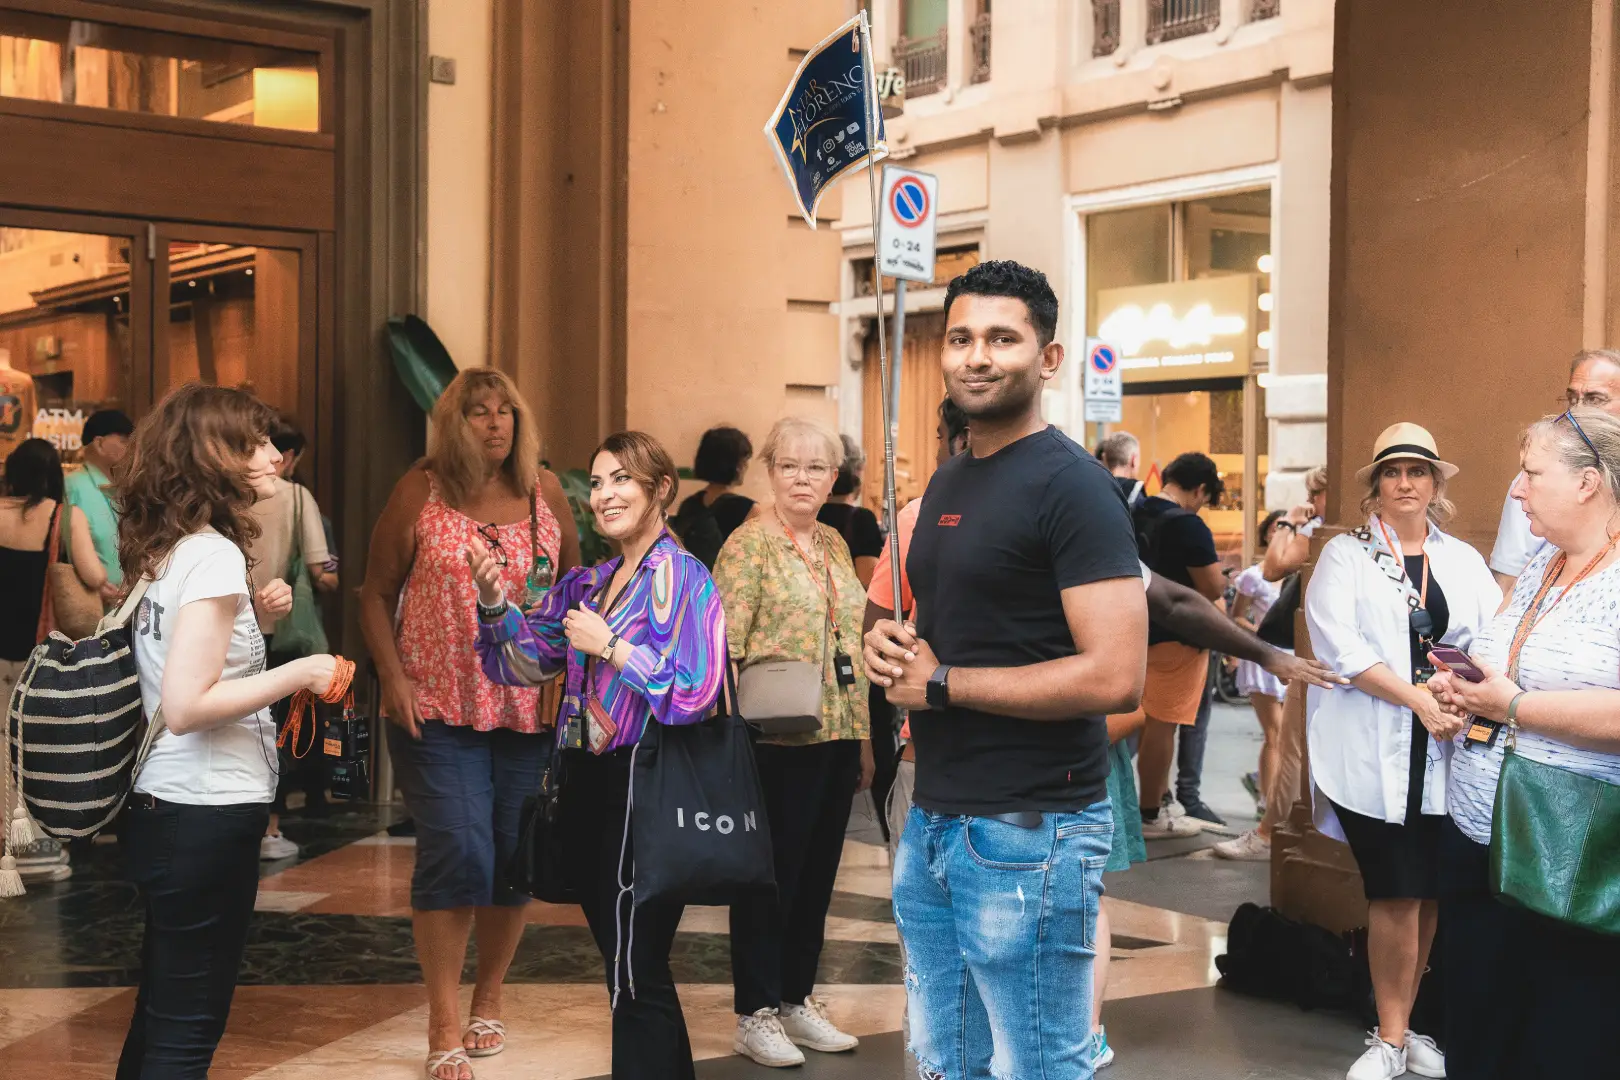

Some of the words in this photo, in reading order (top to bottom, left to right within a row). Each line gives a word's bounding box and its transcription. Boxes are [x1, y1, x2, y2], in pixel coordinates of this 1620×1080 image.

[796, 78, 818, 118] STAR
[34, 407, 83, 426] ATM
[677, 807, 757, 834] ICON
